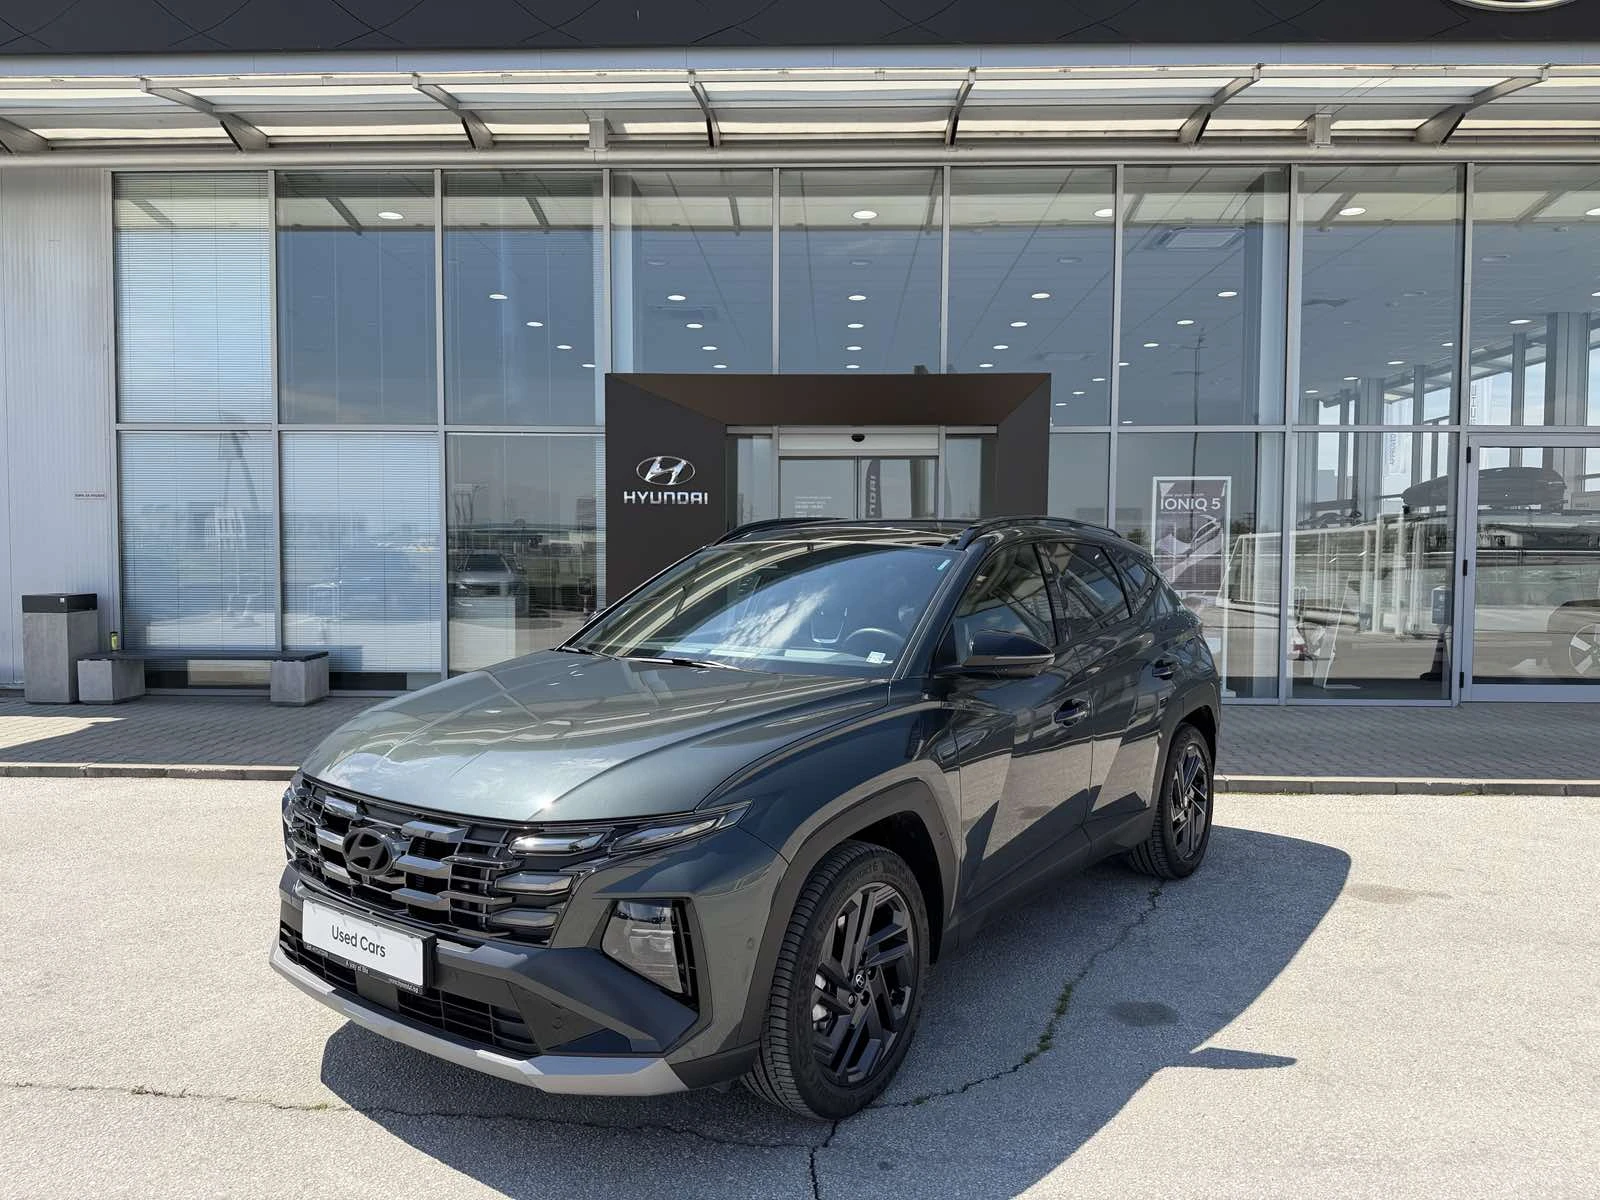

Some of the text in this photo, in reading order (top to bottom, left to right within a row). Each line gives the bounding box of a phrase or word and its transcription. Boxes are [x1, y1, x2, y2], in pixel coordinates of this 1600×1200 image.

[623, 491, 709, 505] HYUNDAI
[1160, 497, 1221, 511] IONIQ 5
[331, 924, 387, 958] Used Cars
